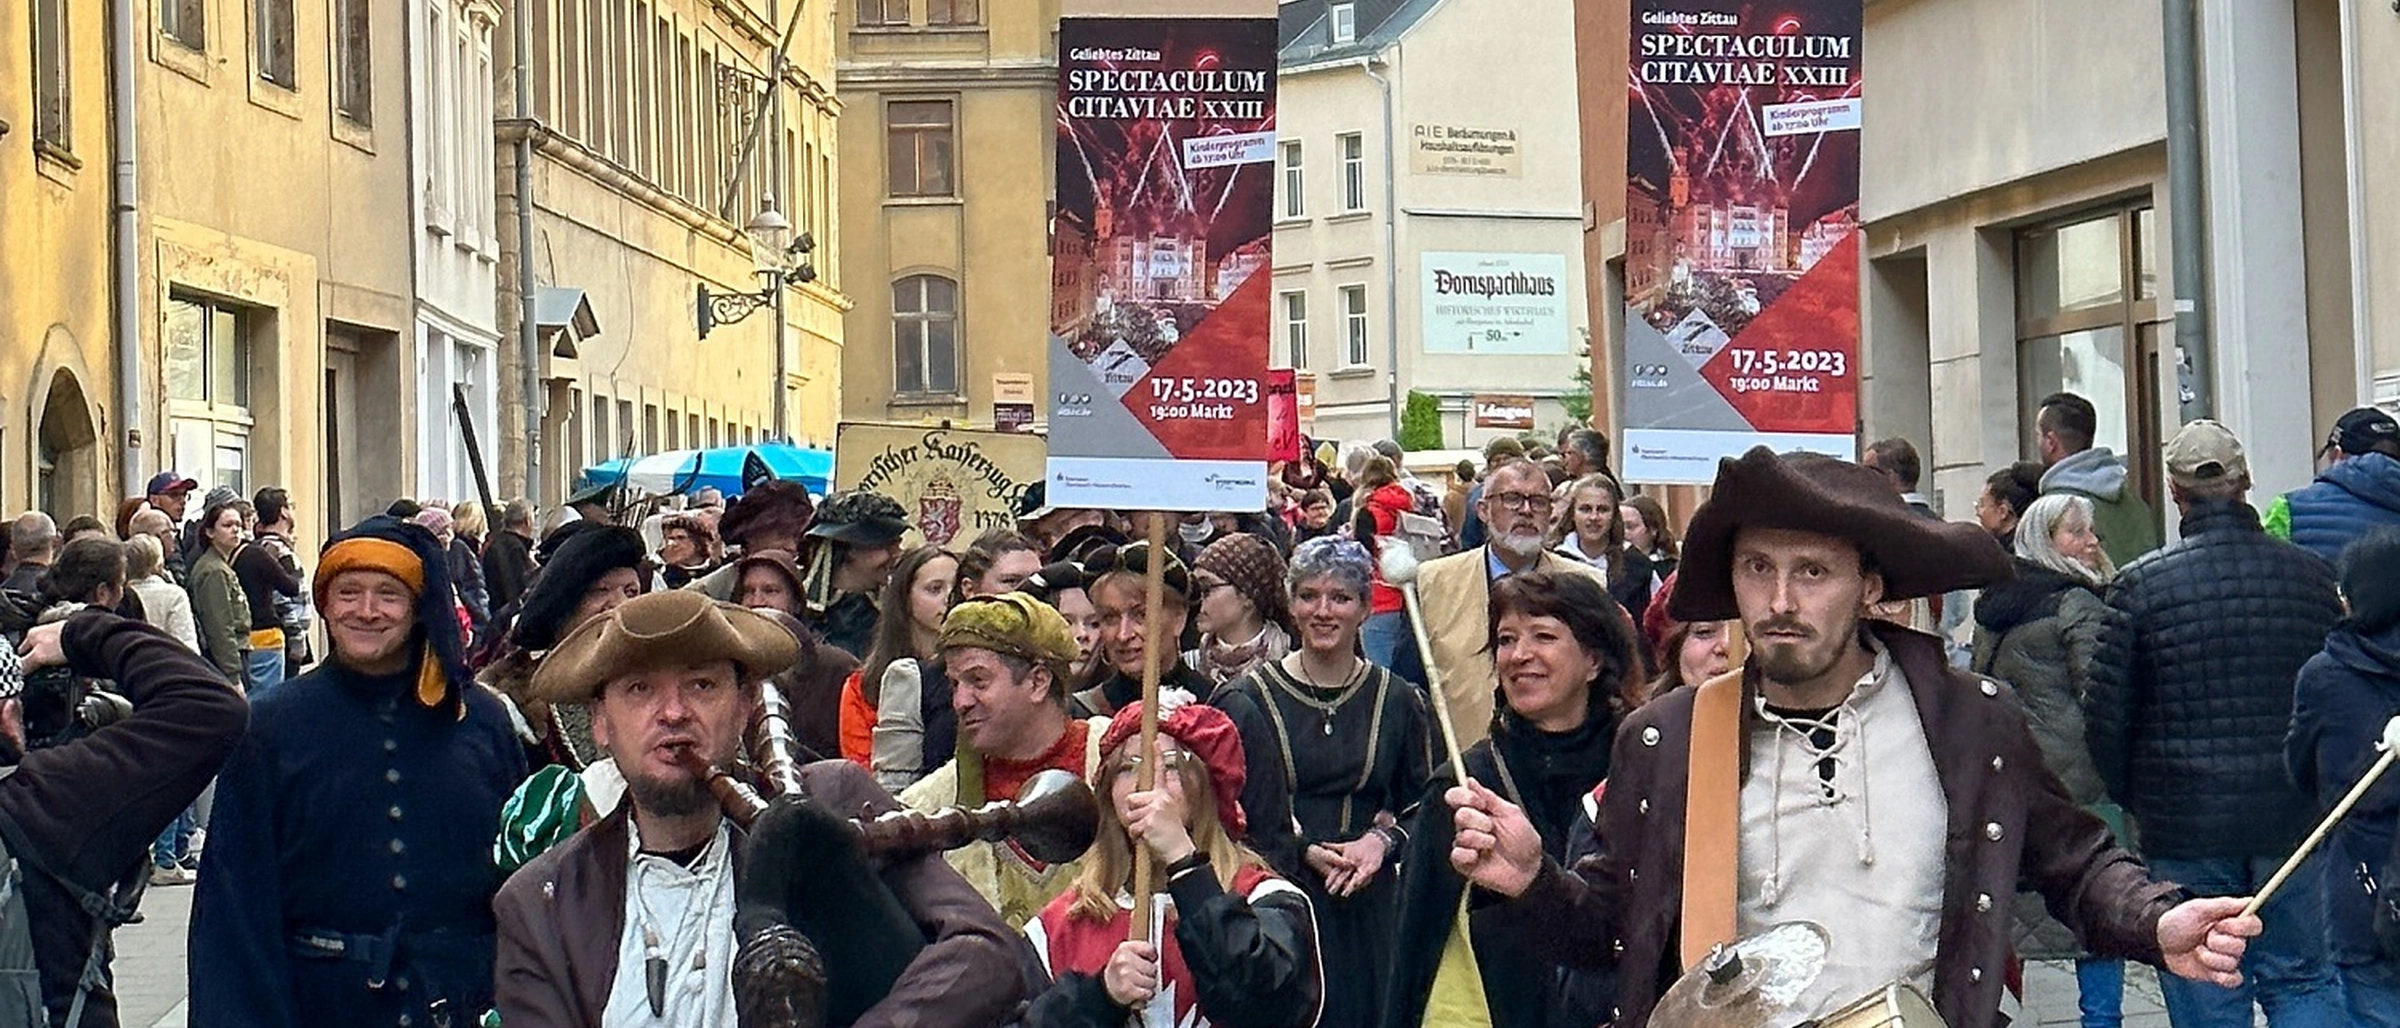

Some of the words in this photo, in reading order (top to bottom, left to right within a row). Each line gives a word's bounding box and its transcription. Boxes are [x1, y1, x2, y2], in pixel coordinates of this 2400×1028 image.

[1641, 11, 1698, 25] Geliebtes
[1700, 10, 1738, 26] Zittau
[1069, 48, 1124, 61] Geliebtes
[1125, 48, 1160, 61] Zittau
[1640, 34, 1852, 58] SPECTACULUM
[1068, 70, 1267, 92] SPECTACULUM
[1640, 61, 1776, 85] CITAVIAE
[1784, 66, 1849, 86] XXIII
[1068, 96, 1196, 119] CITAVIAE
[1202, 100, 1265, 119] XXIII
[1769, 105, 1851, 120] Kinderprogramm
[1811, 117, 1829, 128] Uhr
[1190, 138, 1265, 153] Kinderprogramm
[1228, 150, 1245, 160] Uhr
[1433, 268, 1555, 300] Dornspachhaus
[1730, 348, 1846, 376] 17.5.2023
[1150, 377, 1259, 404] 17.5.2023
[1730, 377, 1770, 393] 19:00
[1773, 376, 1820, 392] Markt
[1150, 405, 1187, 420] 19:00
[1190, 403, 1233, 419] Markt
[858, 443, 918, 491] orischer
[922, 430, 1013, 499] Kaiserzug
[975, 509, 1011, 529] 1376
